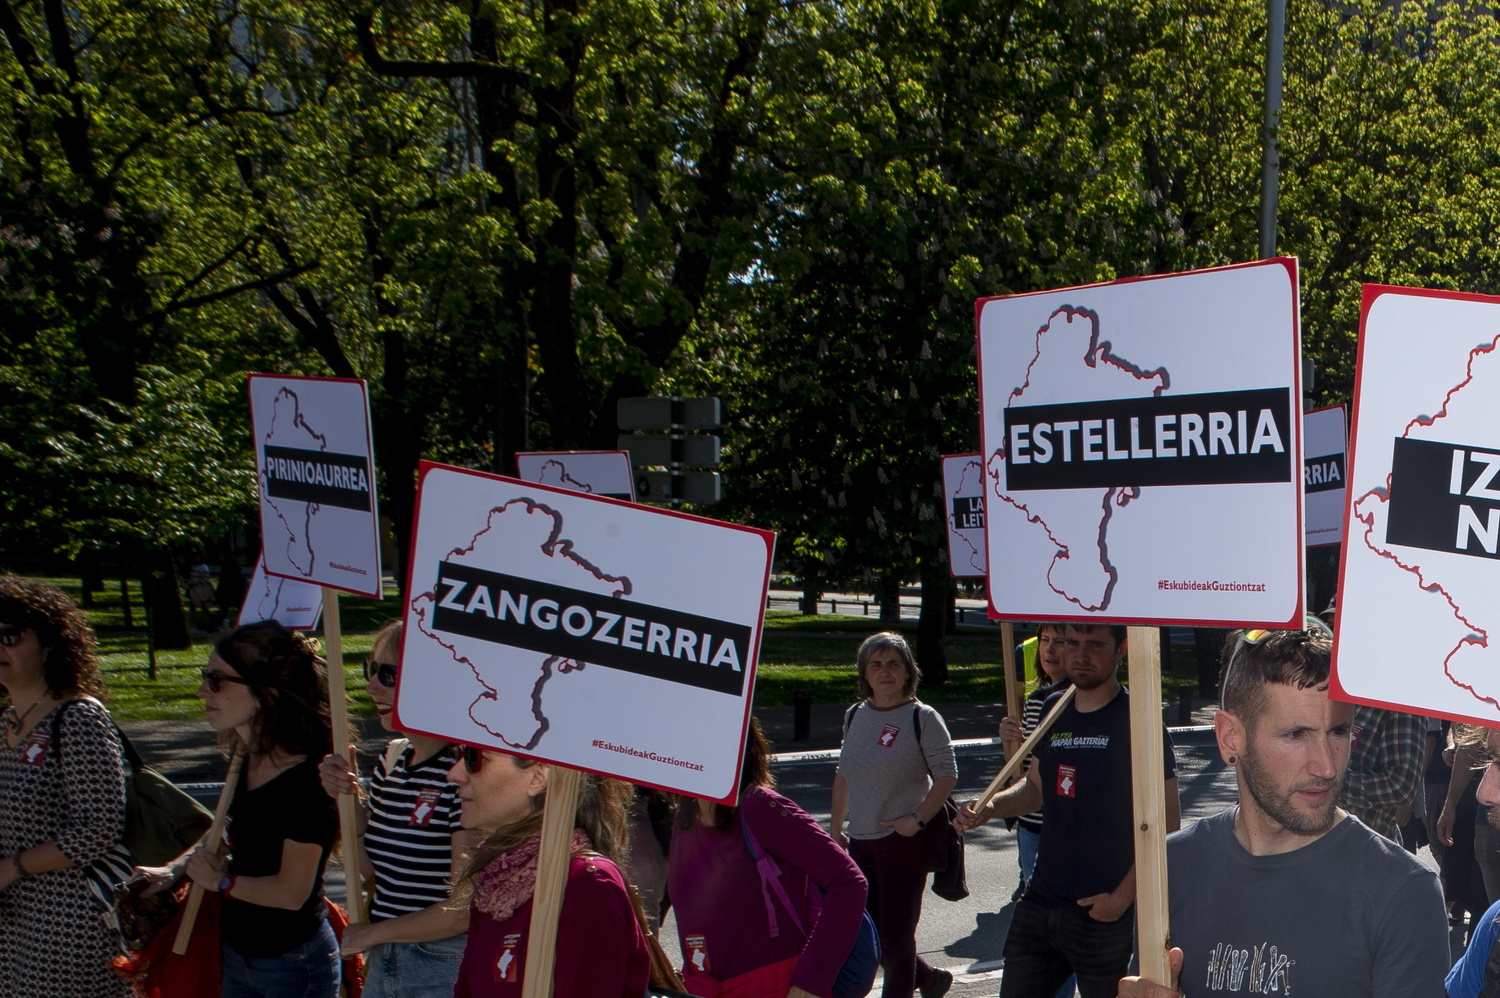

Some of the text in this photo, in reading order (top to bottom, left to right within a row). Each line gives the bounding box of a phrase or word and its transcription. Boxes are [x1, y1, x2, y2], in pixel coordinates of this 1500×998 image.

[1010, 408, 1285, 465] ESTELLERRIA
[266, 456, 369, 492] PIRINIOAURREA
[1157, 580, 1266, 592] #EskubideakGuztiontzat
[438, 577, 742, 672] ZANGOZERRIA
[592, 739, 704, 772] #EskubideakGuztiontzat
